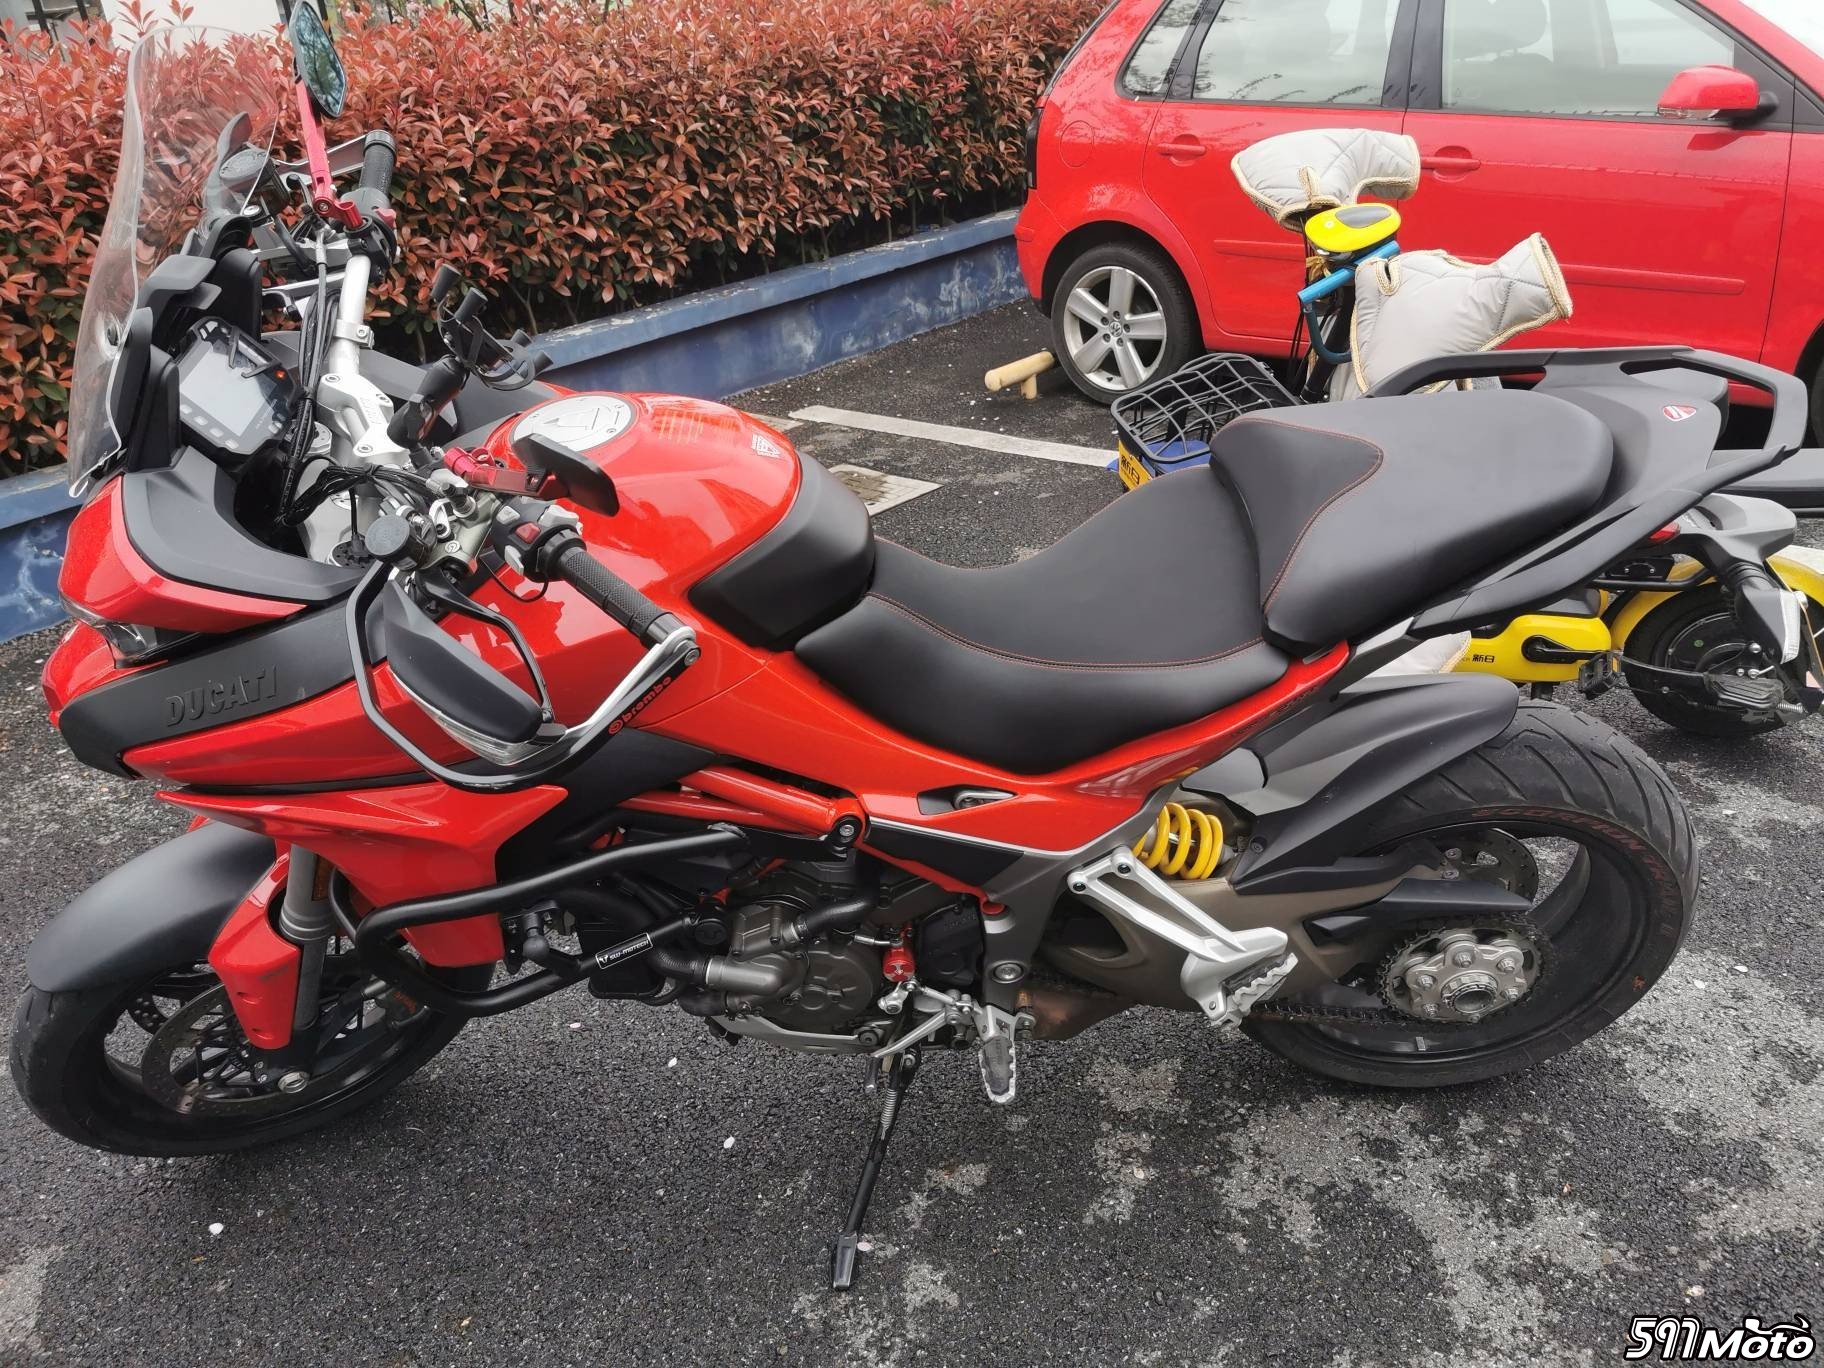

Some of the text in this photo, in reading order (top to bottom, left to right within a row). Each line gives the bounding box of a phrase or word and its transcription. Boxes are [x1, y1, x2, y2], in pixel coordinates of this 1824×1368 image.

[1472, 653, 1495, 664] 新日
[165, 664, 279, 728] DUCATI
[621, 676, 672, 723] brembo
